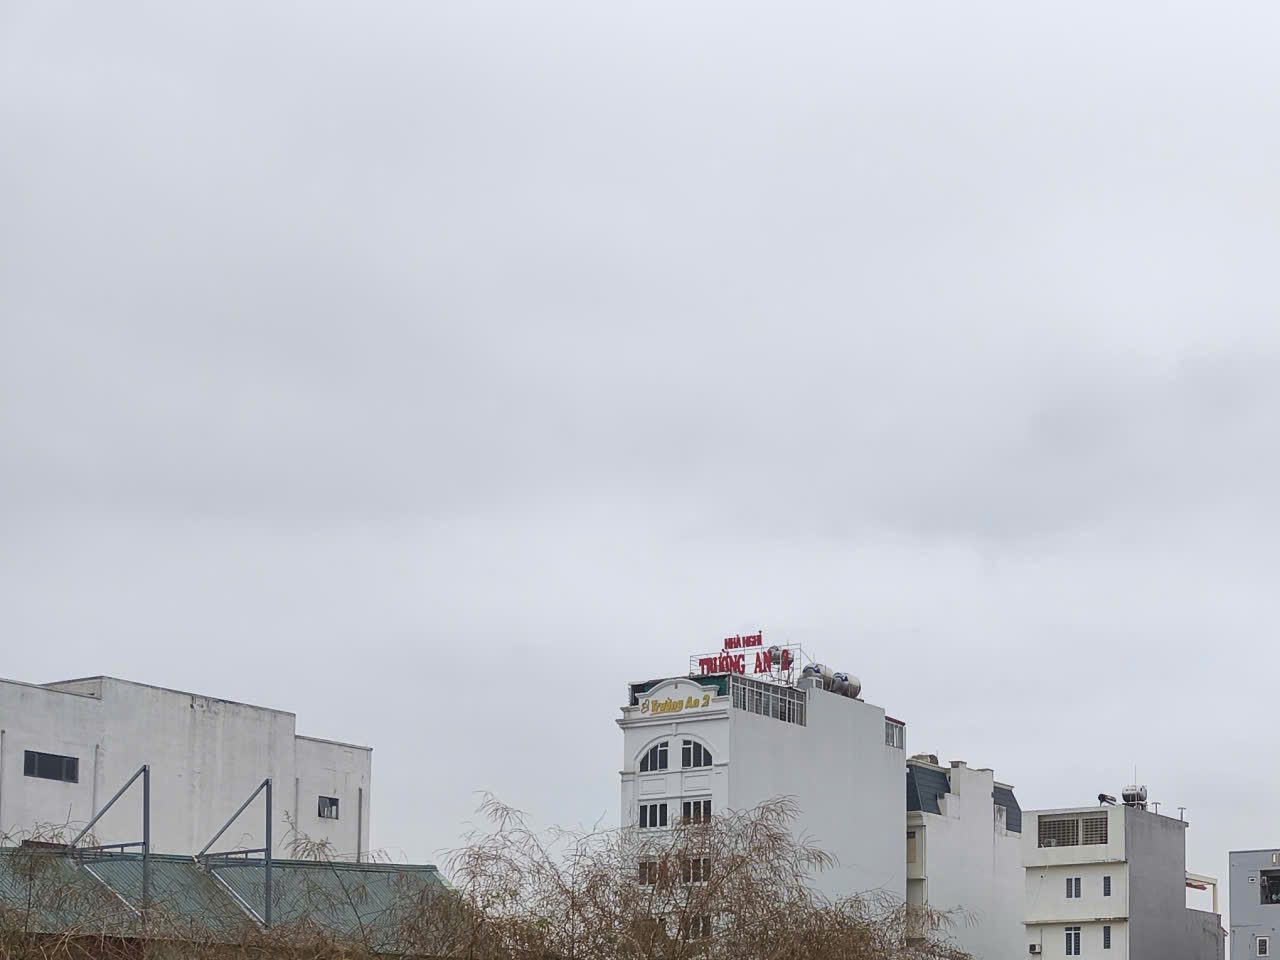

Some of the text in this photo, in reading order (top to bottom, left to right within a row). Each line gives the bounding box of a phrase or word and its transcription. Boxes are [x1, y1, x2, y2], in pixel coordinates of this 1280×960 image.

[754, 650, 772, 674] AN
[781, 649, 790, 671] 2
[685, 696, 699, 709] An
[701, 694, 710, 708] 2
